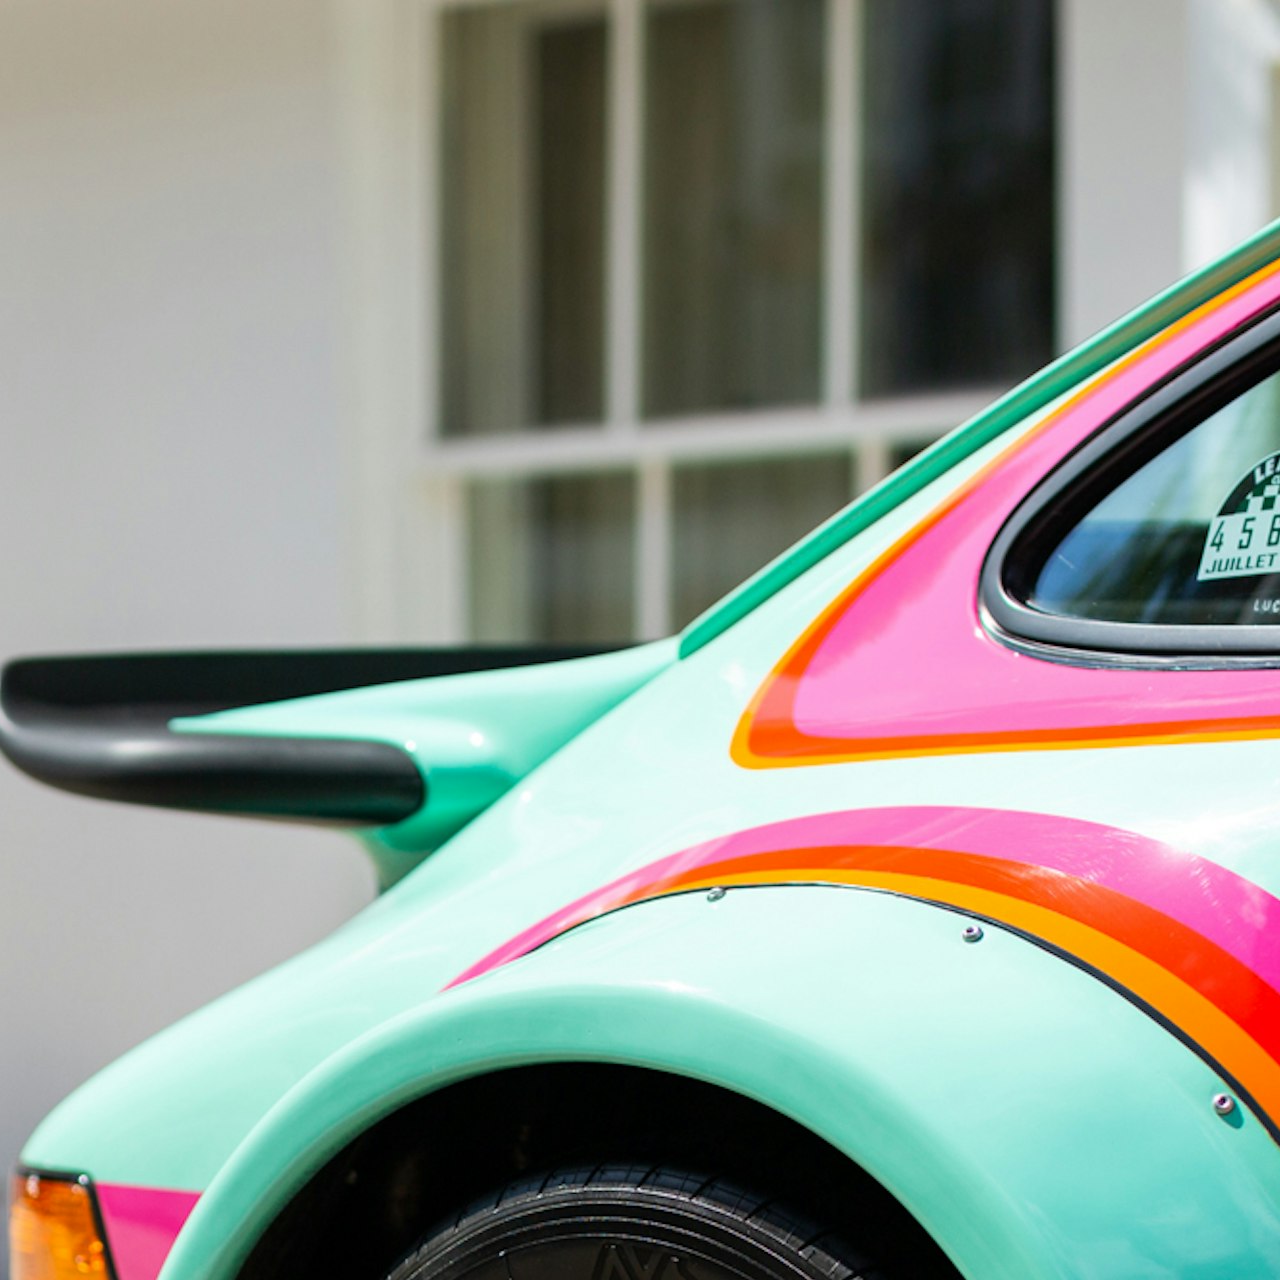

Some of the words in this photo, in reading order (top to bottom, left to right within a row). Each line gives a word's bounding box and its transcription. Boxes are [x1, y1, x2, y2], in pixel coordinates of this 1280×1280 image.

[1254, 458, 1275, 483] LE
[1210, 519, 1225, 552] 4
[1237, 516, 1257, 550] 5
[1204, 552, 1279, 574] JUILLET
